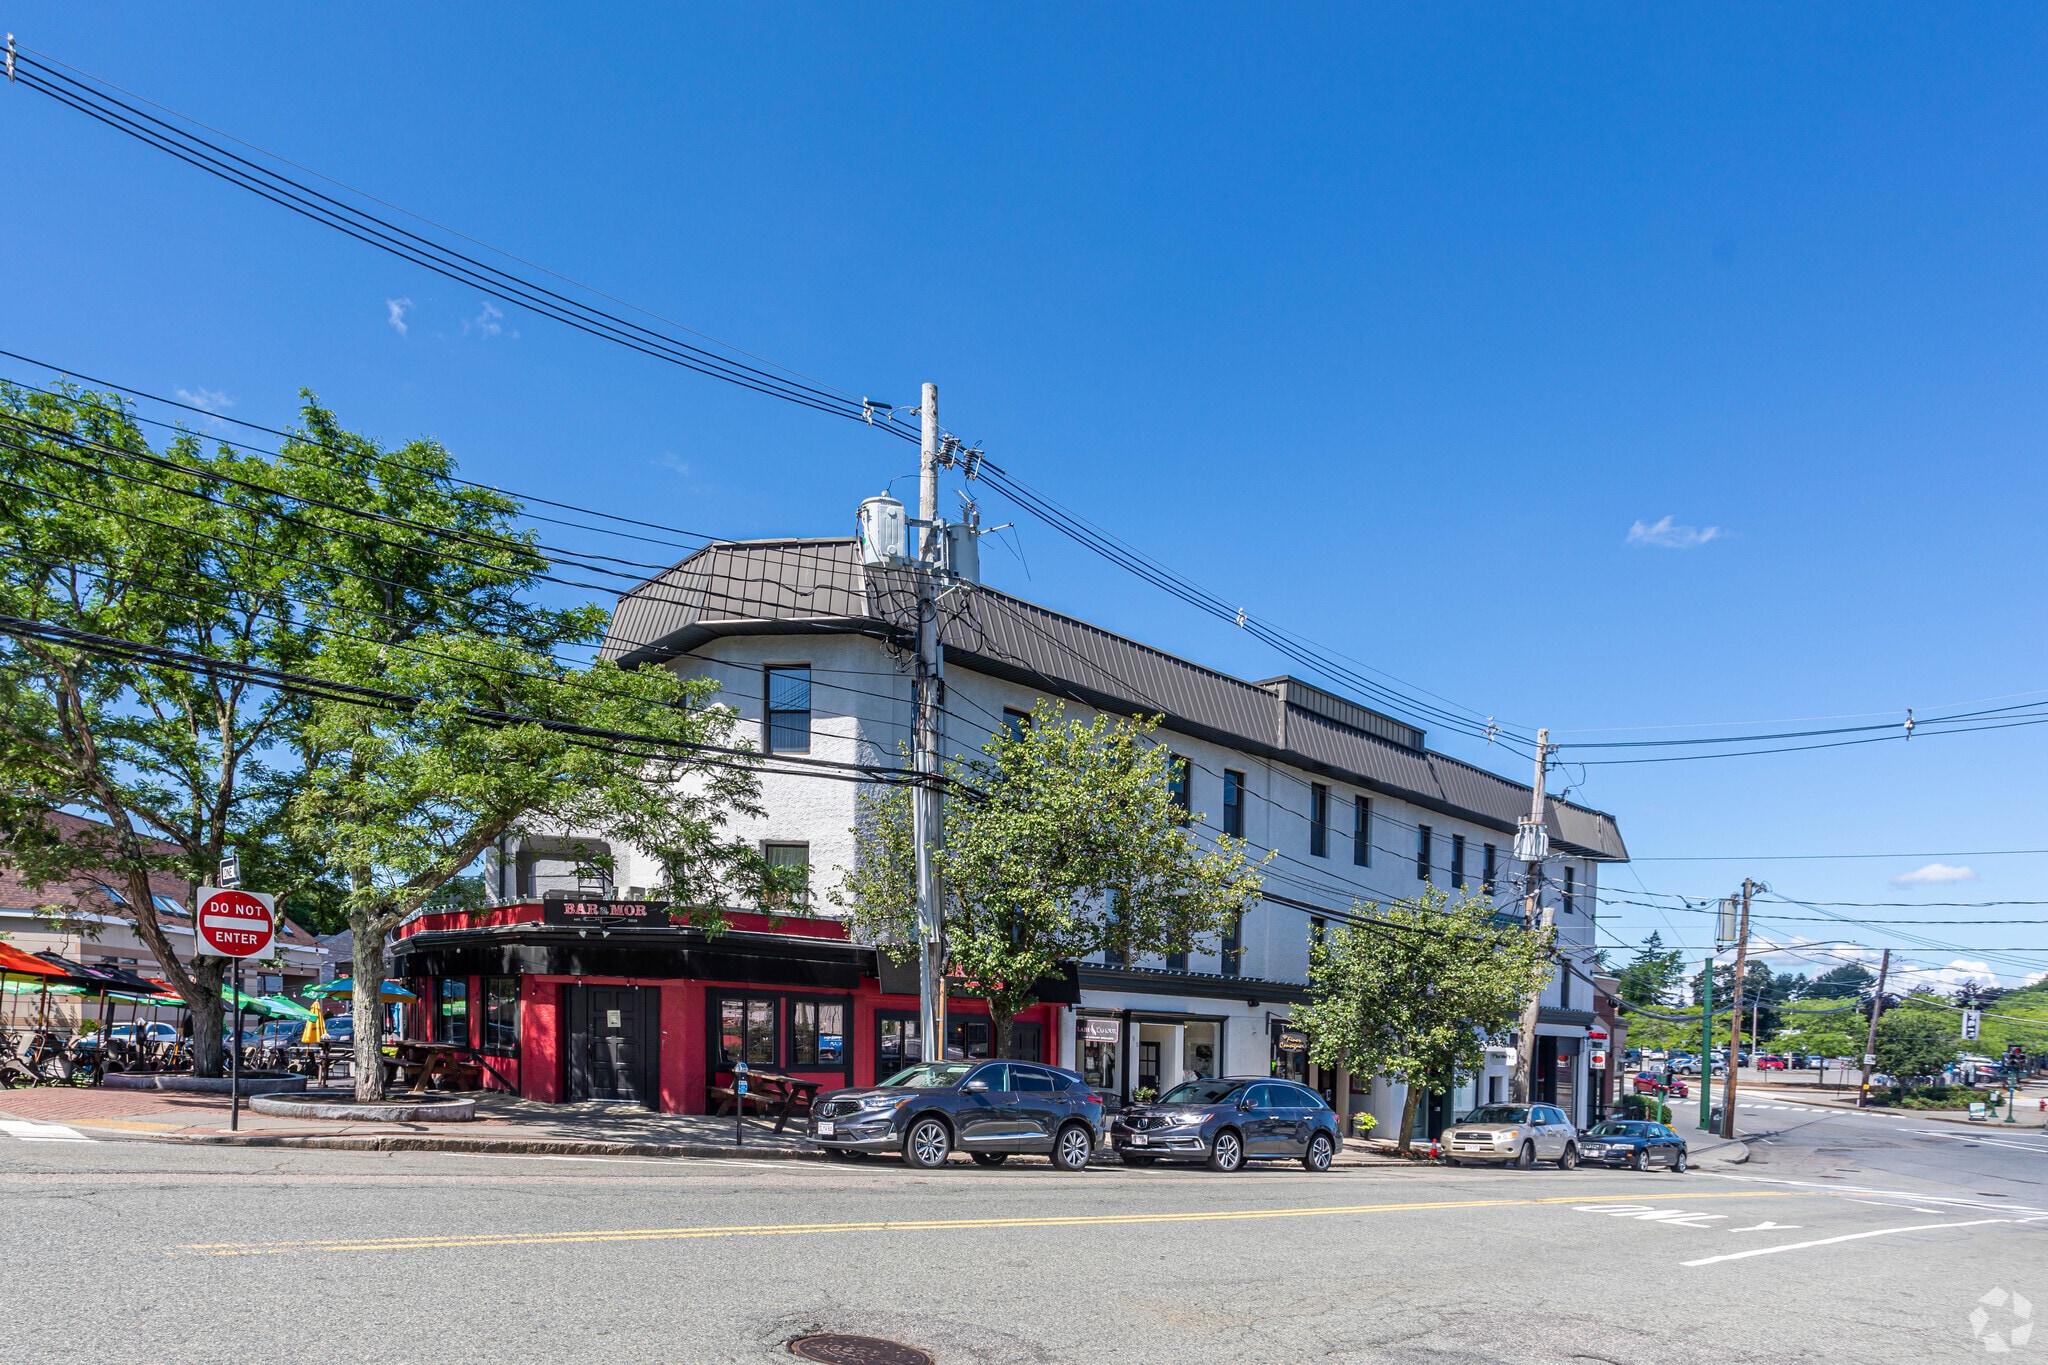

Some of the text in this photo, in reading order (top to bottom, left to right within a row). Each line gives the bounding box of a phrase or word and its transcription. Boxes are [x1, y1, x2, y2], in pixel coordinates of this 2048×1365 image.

[210, 901, 262, 917] DO NOT
[564, 903, 598, 915] BAR
[609, 904, 647, 916] MOR
[215, 931, 258, 945] ENTER
[1572, 1204, 1803, 1233] ONLY
